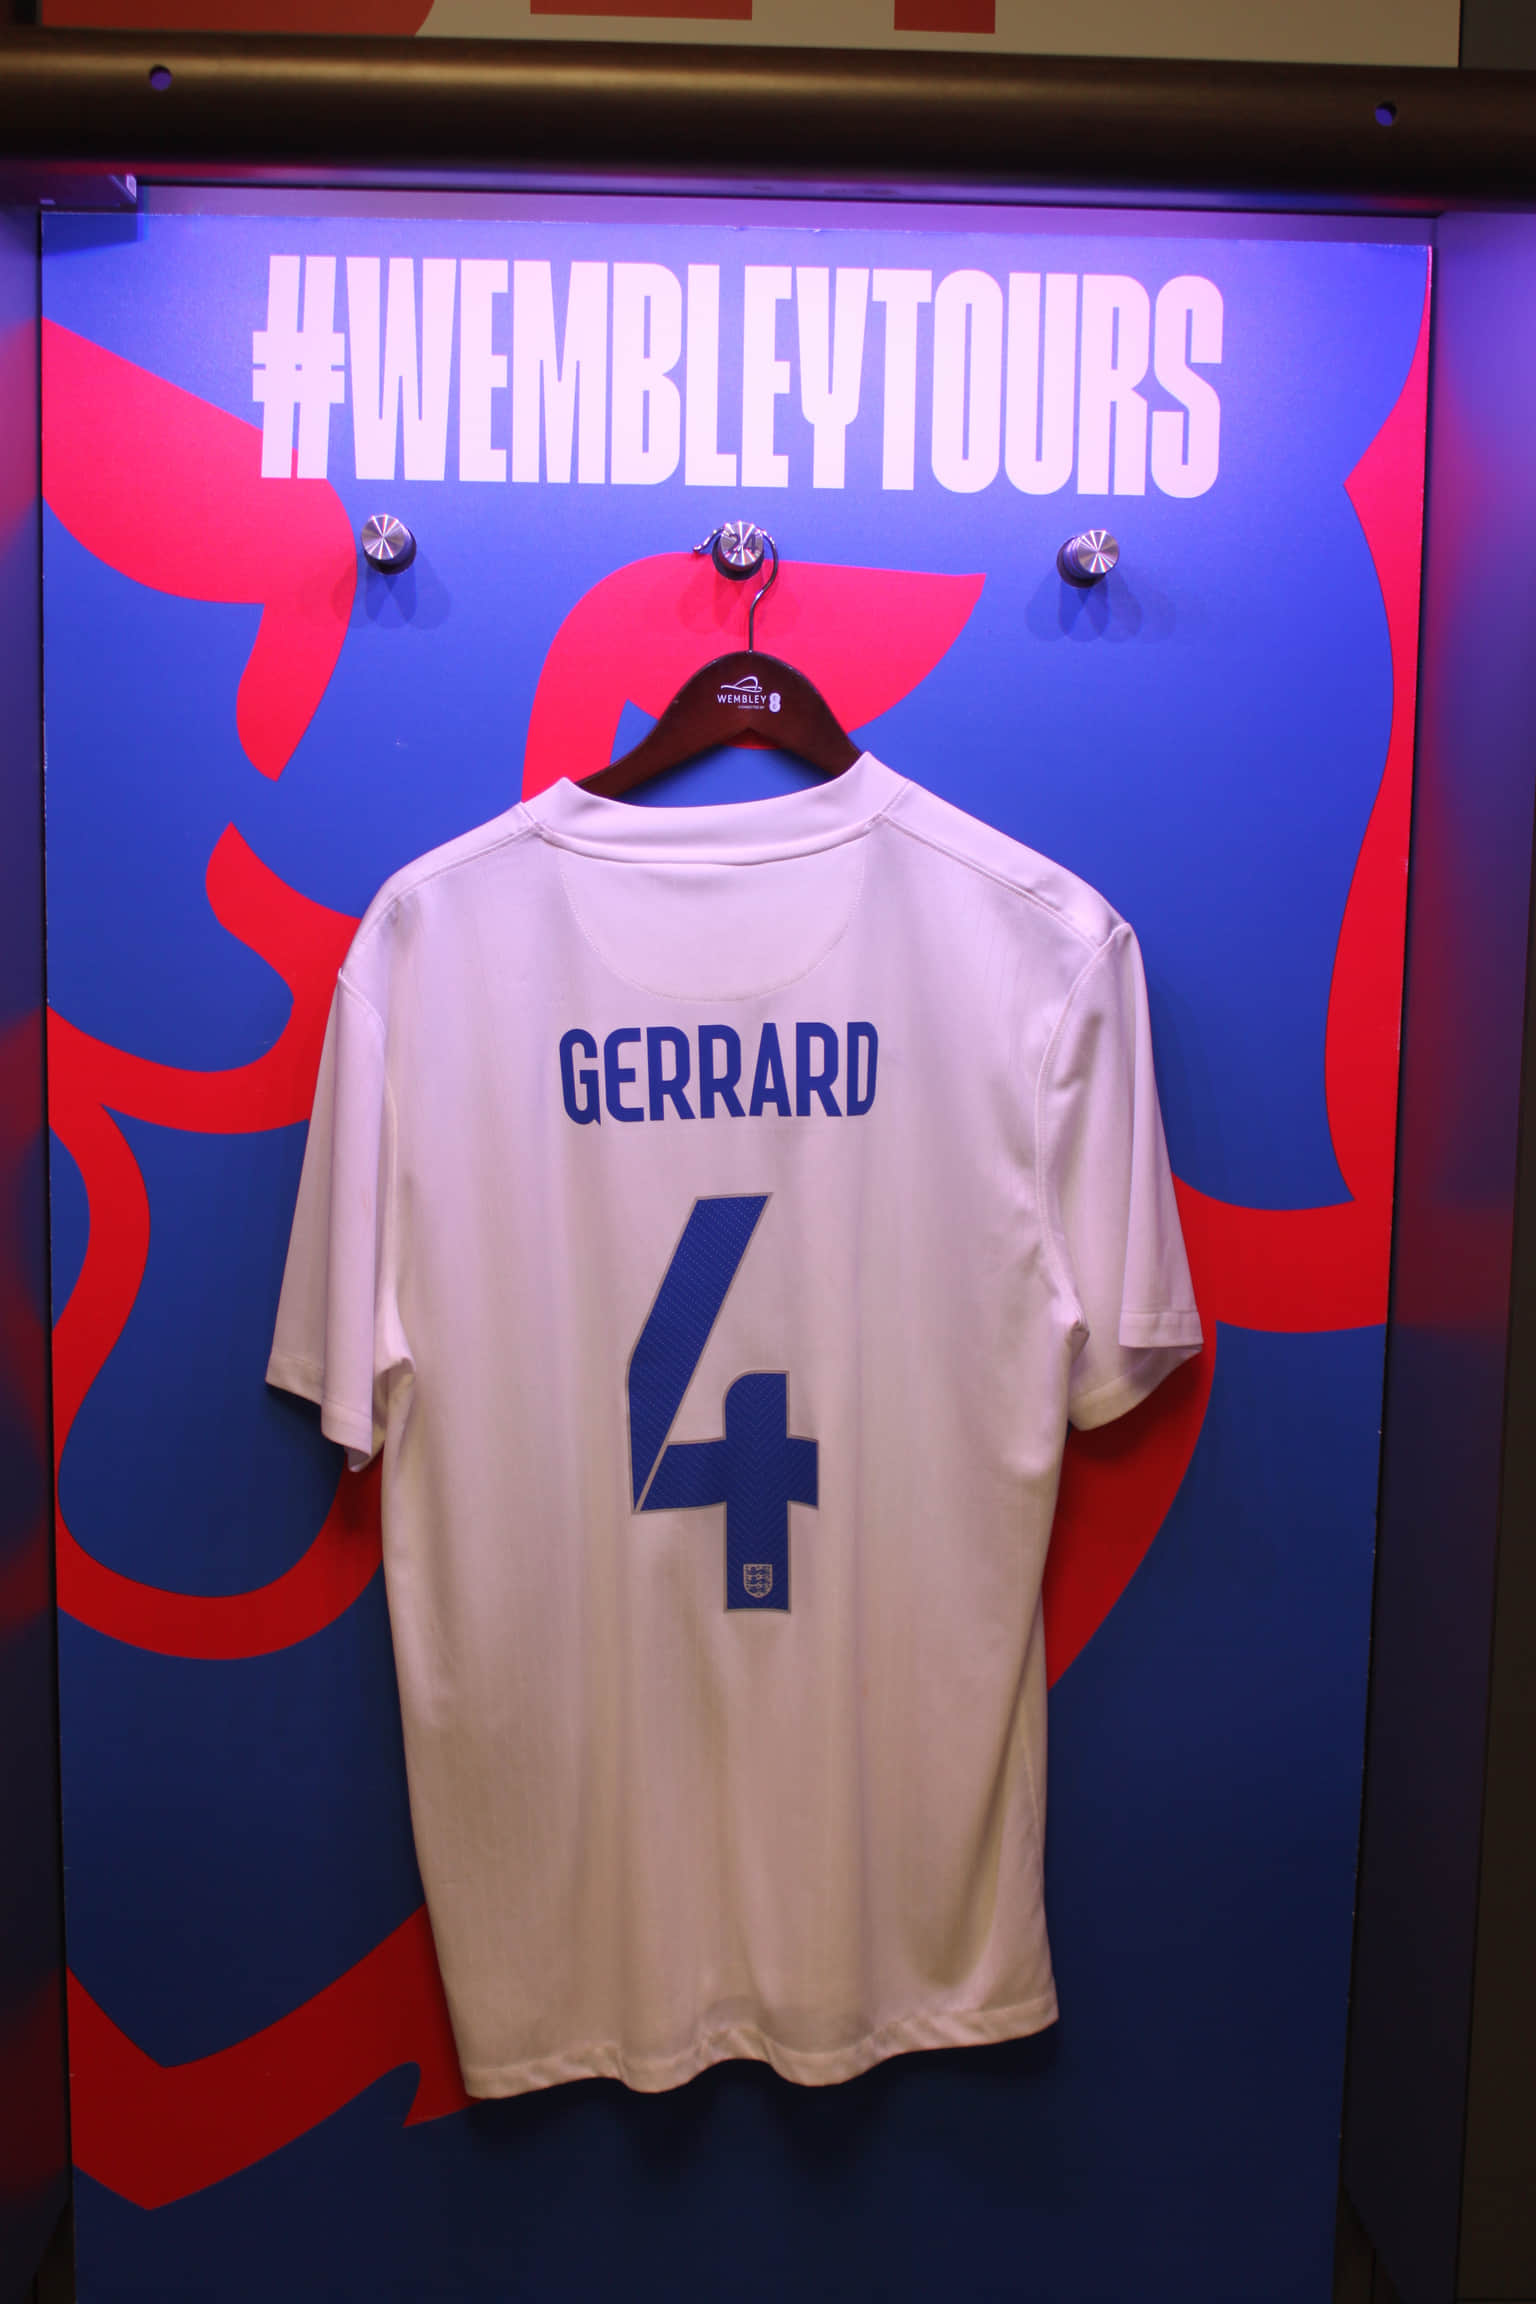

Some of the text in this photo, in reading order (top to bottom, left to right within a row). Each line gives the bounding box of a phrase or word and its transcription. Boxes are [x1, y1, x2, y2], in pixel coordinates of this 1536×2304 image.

[252, 255, 1224, 499] #WEMBLEYTOURS
[727, 532, 757, 554] 24
[716, 694, 767, 704] WEMBLEY
[559, 1021, 879, 1125] GERRARD
[627, 1192, 819, 1612] 4
